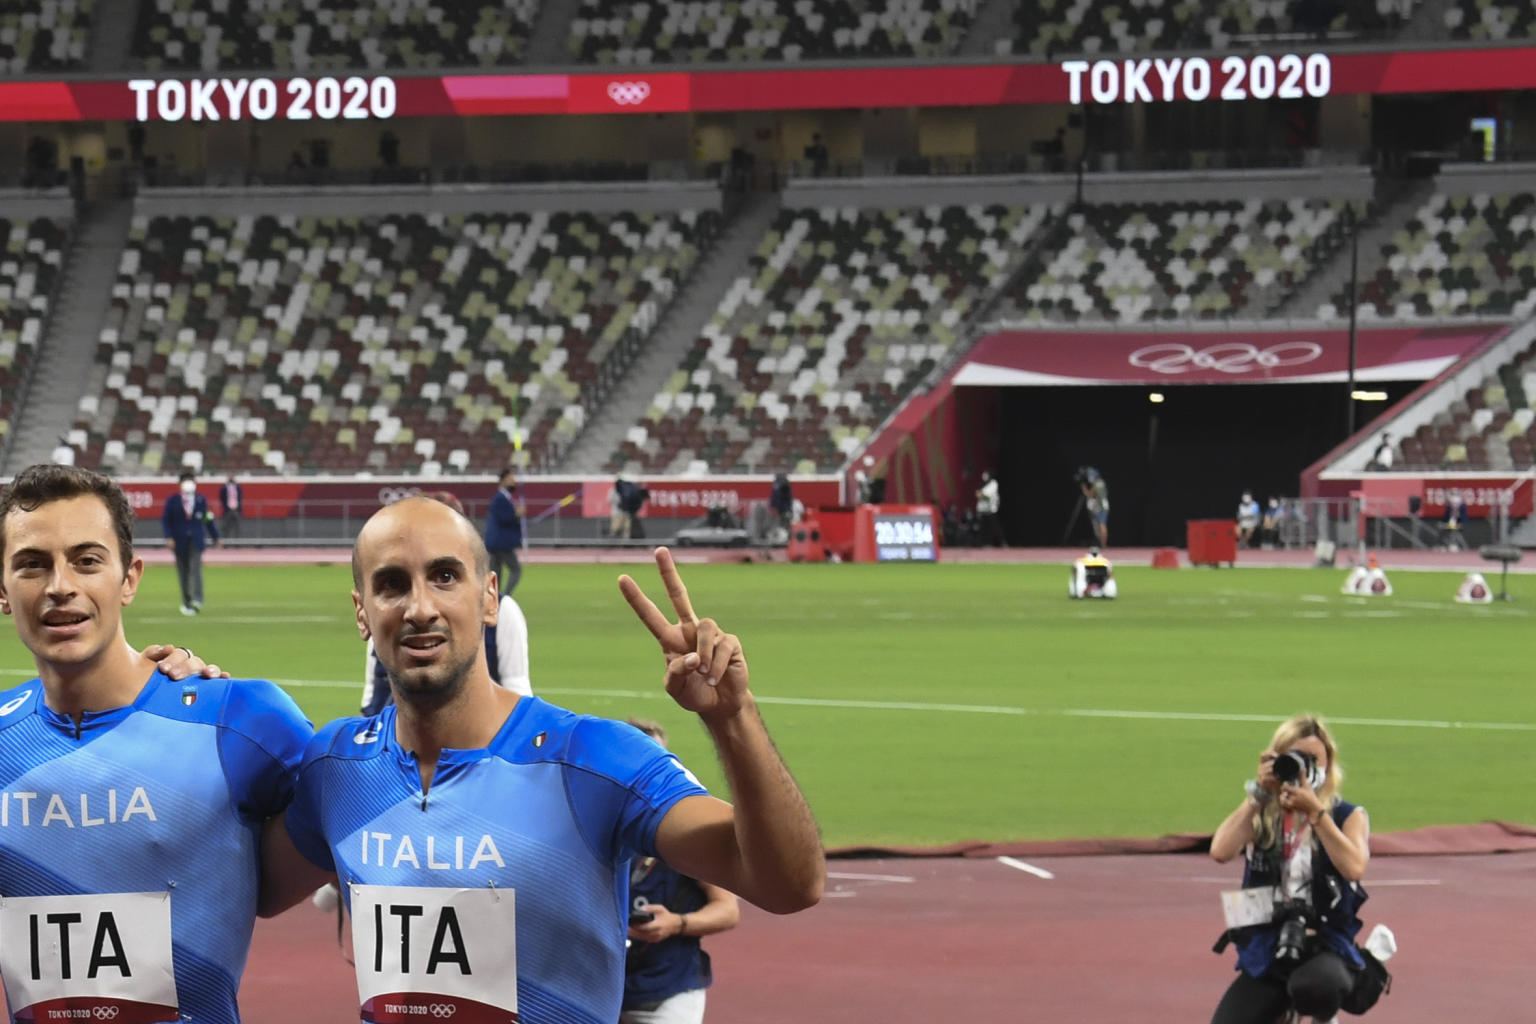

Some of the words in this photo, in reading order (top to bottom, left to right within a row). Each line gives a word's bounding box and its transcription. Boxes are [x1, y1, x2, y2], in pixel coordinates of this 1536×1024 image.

[128, 78, 277, 122] TOKYO
[286, 76, 396, 120] 2020
[1061, 57, 1211, 104] TOKYO
[1220, 53, 1331, 100] 2020
[125, 491, 153, 508] 020
[648, 489, 699, 507] TOKYO
[1, 786, 158, 829] ITALIA
[361, 830, 506, 870] ITALIA
[29, 911, 132, 980] ITA
[374, 904, 472, 976] ITA
[47, 1009, 72, 1019] TOKYO
[73, 1009, 91, 1018] 2020
[384, 1004, 408, 1014] TOKYO
[409, 1005, 428, 1015] 2020
